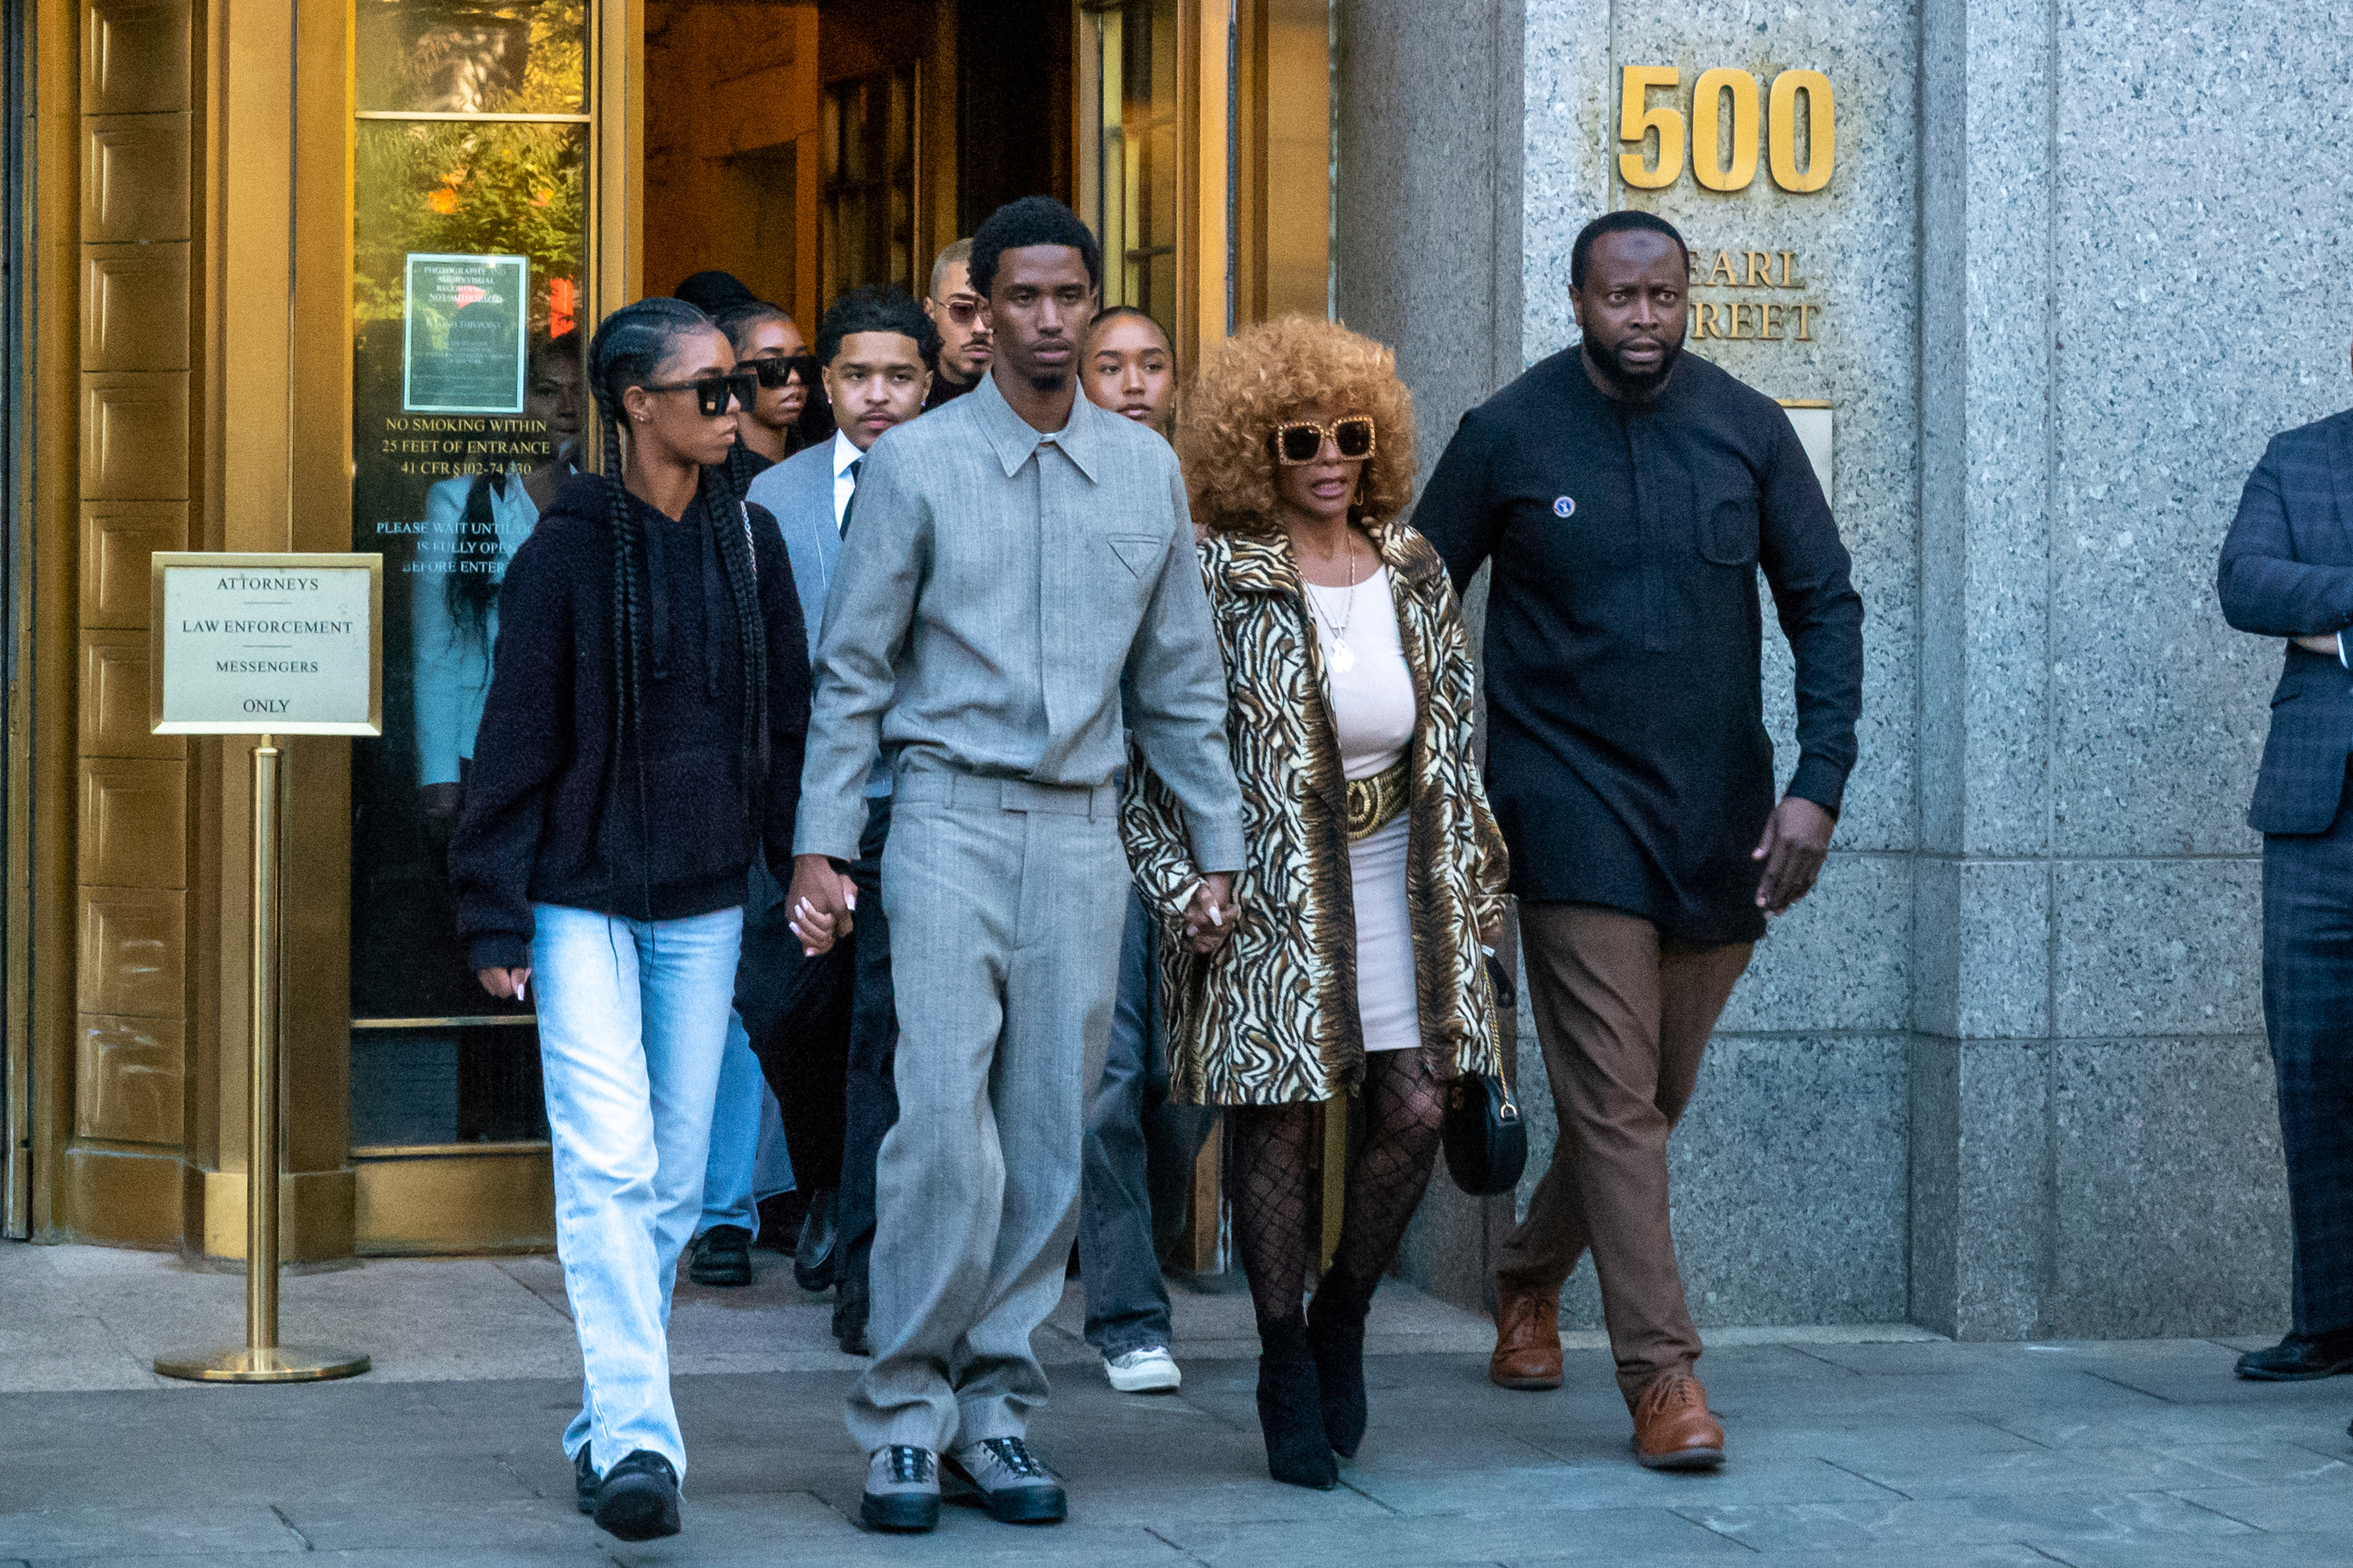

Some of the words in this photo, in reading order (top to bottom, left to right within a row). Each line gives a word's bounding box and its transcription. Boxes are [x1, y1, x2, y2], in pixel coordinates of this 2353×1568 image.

[1619, 65, 1835, 193] 500
[1688, 249, 1805, 289] EARL
[1689, 302, 1819, 341] REET
[386, 418, 408, 431] NO
[412, 419, 485, 432] SMOKING
[489, 420, 546, 432] WITHIN
[382, 440, 397, 452] 25
[402, 441, 439, 452] FEET
[443, 441, 463, 453] OF
[468, 441, 551, 454] ENTRANCE
[401, 462, 415, 474] 41
[421, 462, 450, 474] CFR
[376, 522, 428, 534] PLEASE
[432, 523, 468, 534] WAIT
[471, 523, 514, 535] UNTIL
[433, 542, 476, 553] FULLY
[402, 561, 456, 572] BEFORE
[461, 561, 506, 573] ENTER
[216, 577, 319, 590] ATTORNEYS
[182, 620, 219, 633] LAW
[225, 620, 354, 634] ENFORCEMENT
[216, 661, 319, 673] MESSENGERS
[242, 699, 290, 713] ONLY
